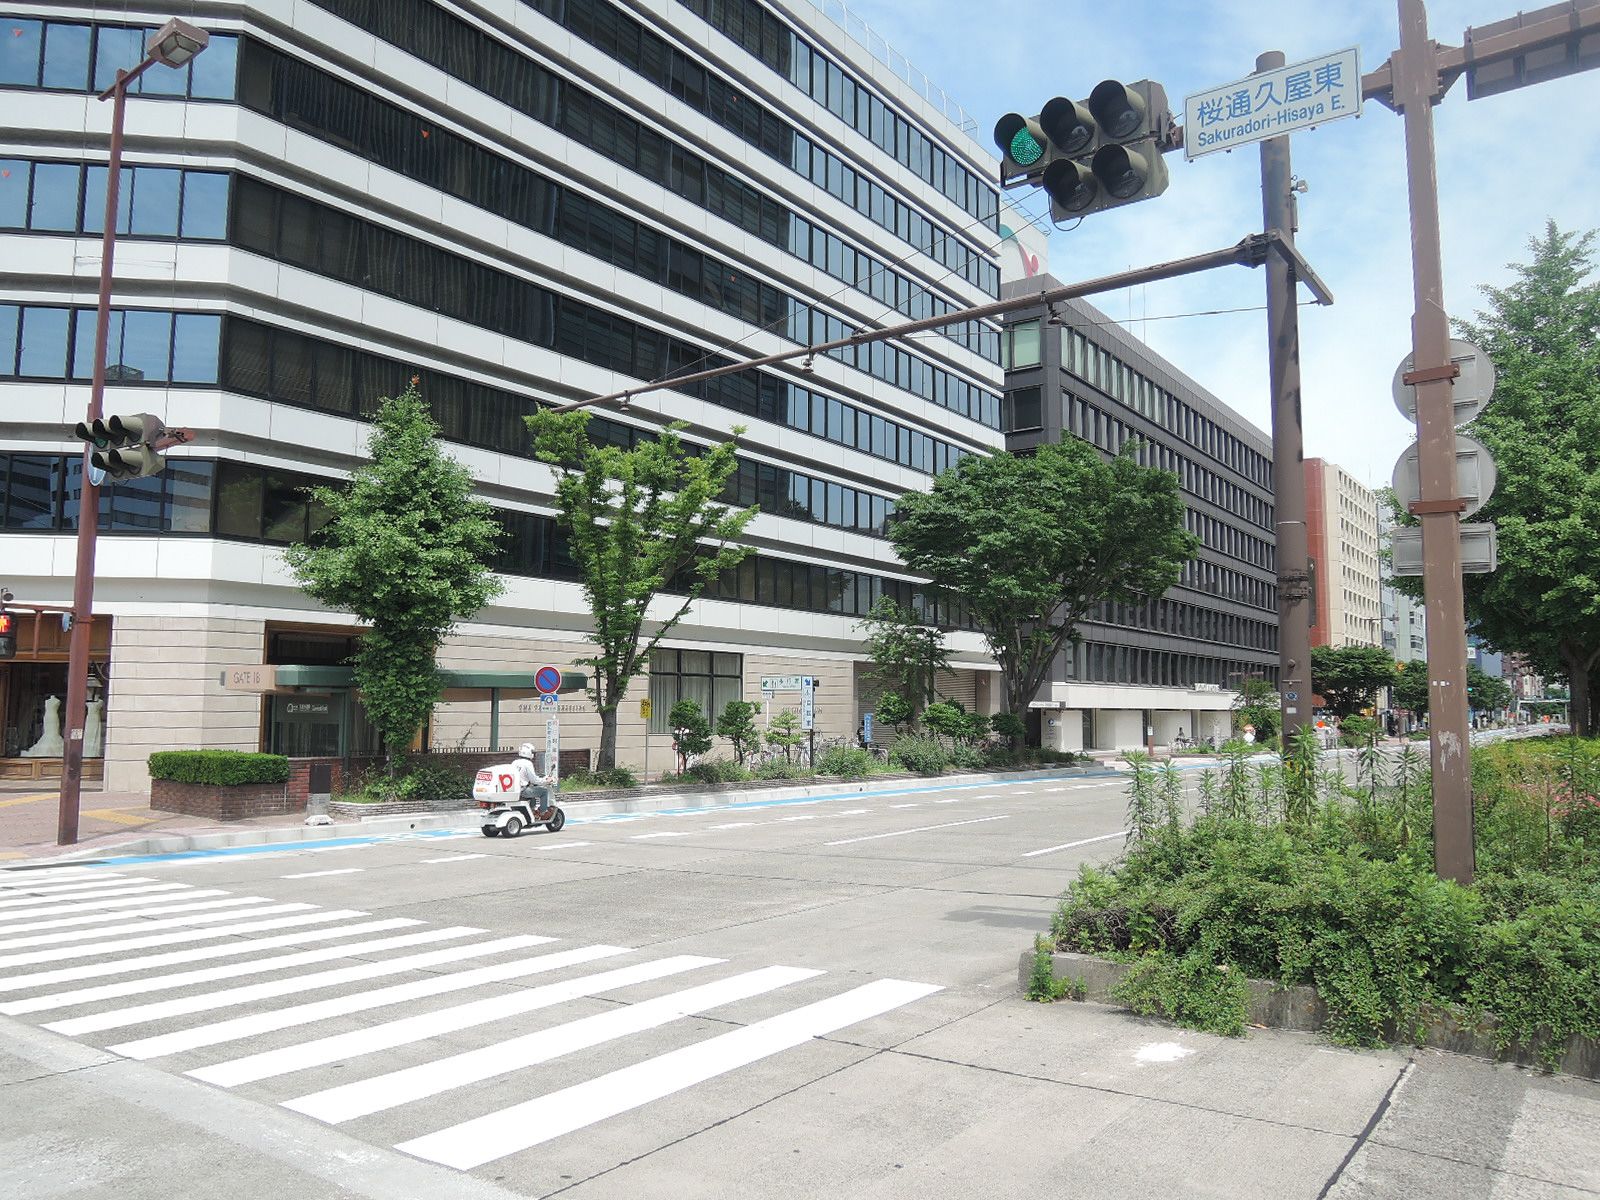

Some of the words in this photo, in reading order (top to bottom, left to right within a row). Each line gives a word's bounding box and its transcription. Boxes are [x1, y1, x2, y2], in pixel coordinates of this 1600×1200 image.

[1197, 61, 1344, 128] 桜通久屋東
[1198, 102, 1324, 147] Sakuradori-Hisaya
[1331, 94, 1345, 111] E.
[233, 671, 250, 684] GATE
